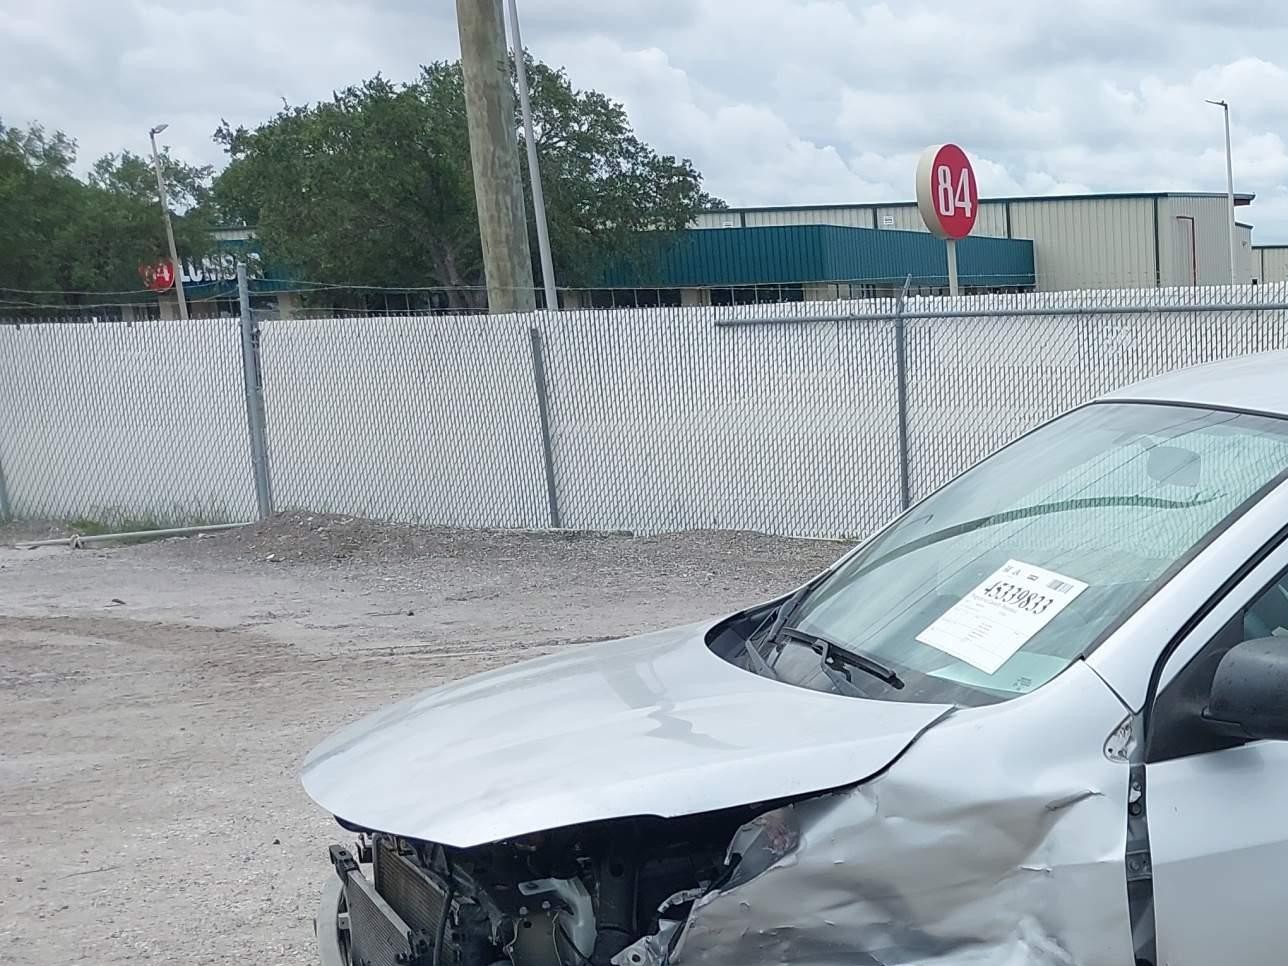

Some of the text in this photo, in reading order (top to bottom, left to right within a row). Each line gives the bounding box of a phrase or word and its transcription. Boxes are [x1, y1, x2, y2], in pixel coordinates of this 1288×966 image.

[938, 166, 972, 217] 84
[179, 253, 264, 282] LUMBR
[984, 581, 1054, 614] 45339833
